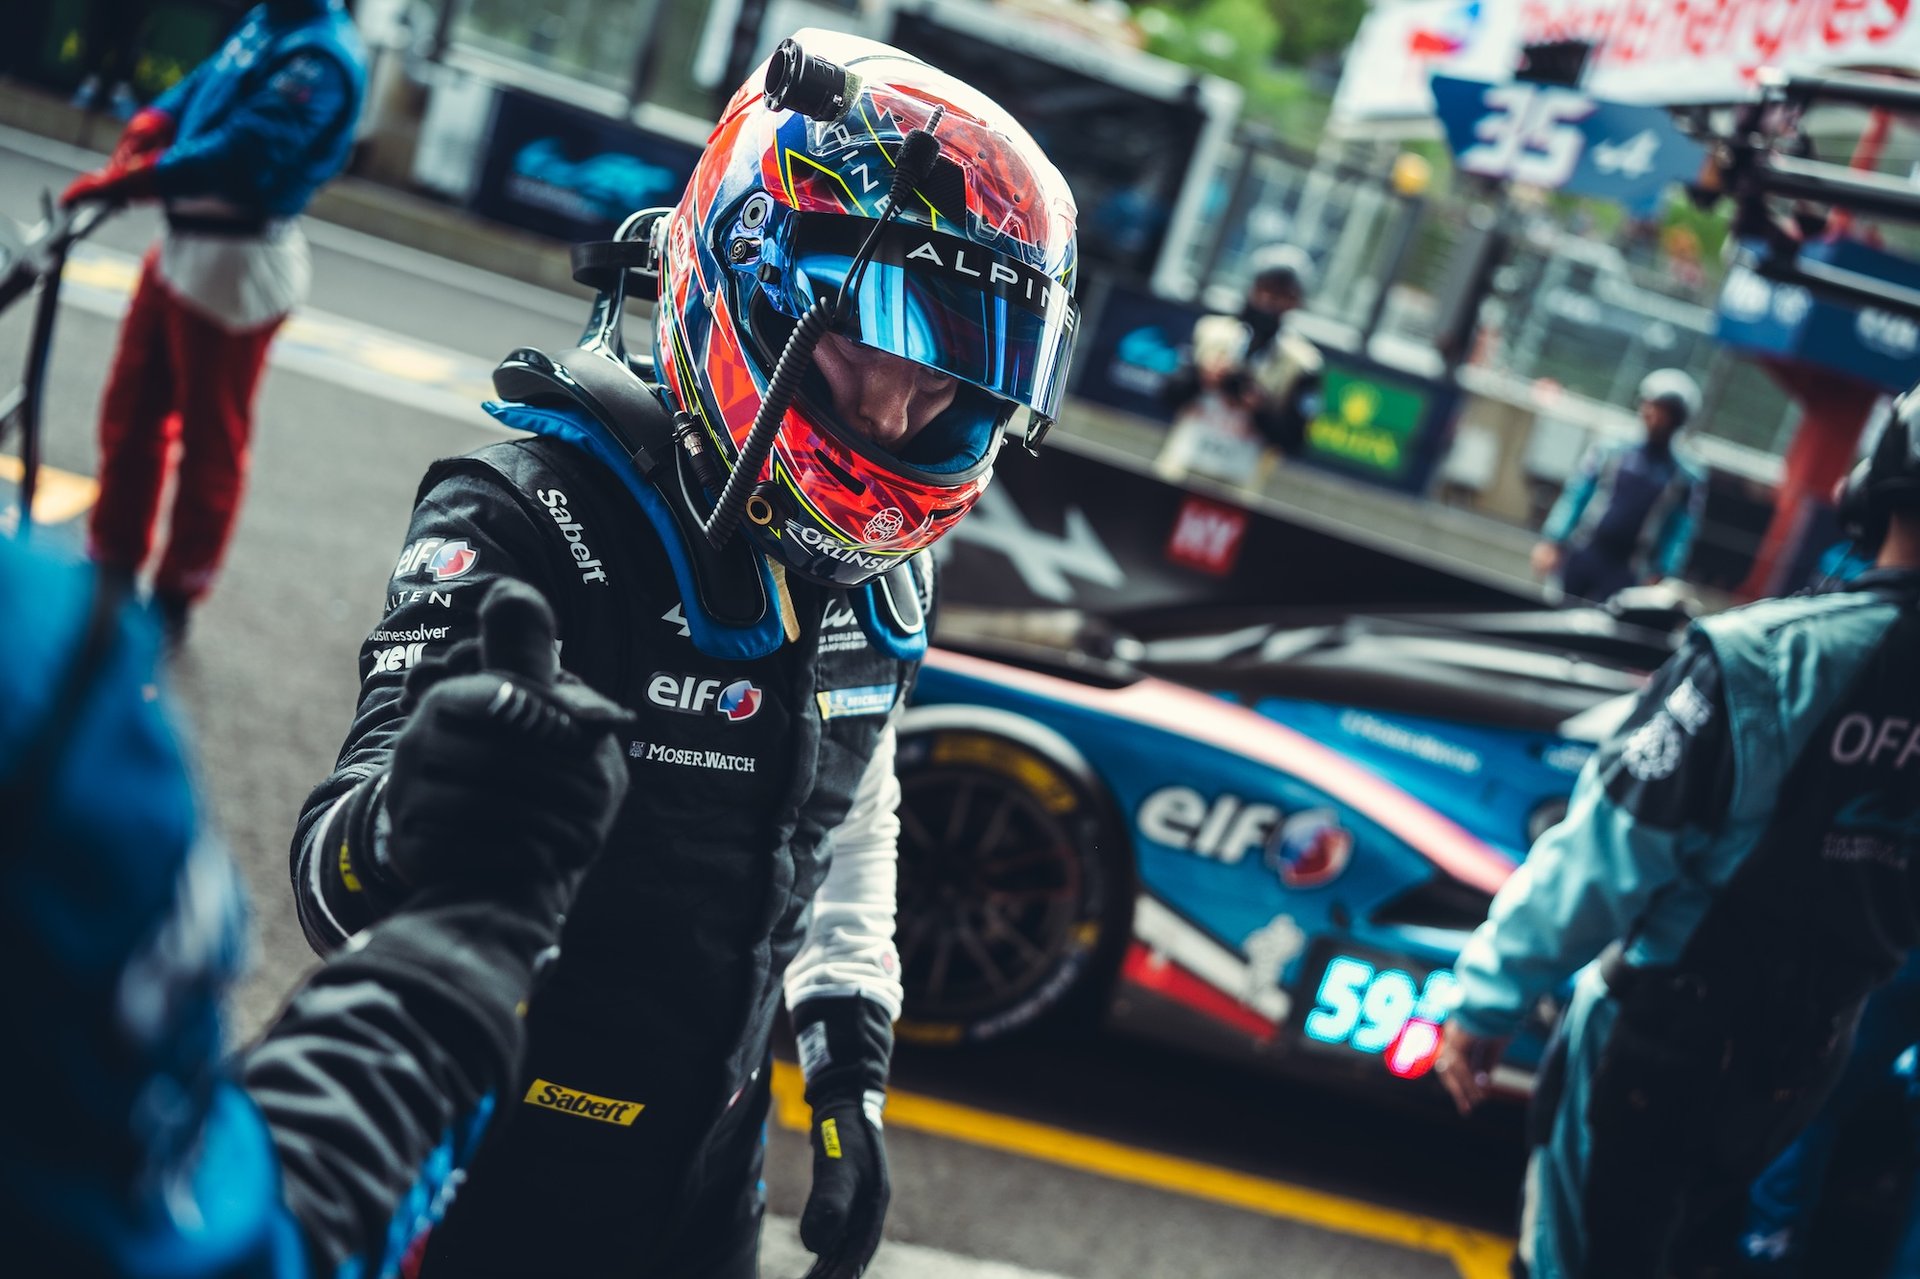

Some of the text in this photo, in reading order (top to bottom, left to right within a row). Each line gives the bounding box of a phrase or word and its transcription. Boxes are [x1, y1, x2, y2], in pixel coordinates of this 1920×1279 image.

[1460, 87, 1598, 188] 35
[906, 241, 1076, 332] ALPINE
[536, 488, 607, 585] Sabelt
[647, 675, 721, 711] elf
[1136, 785, 1280, 864] elf
[537, 1084, 630, 1122] Sabelt
